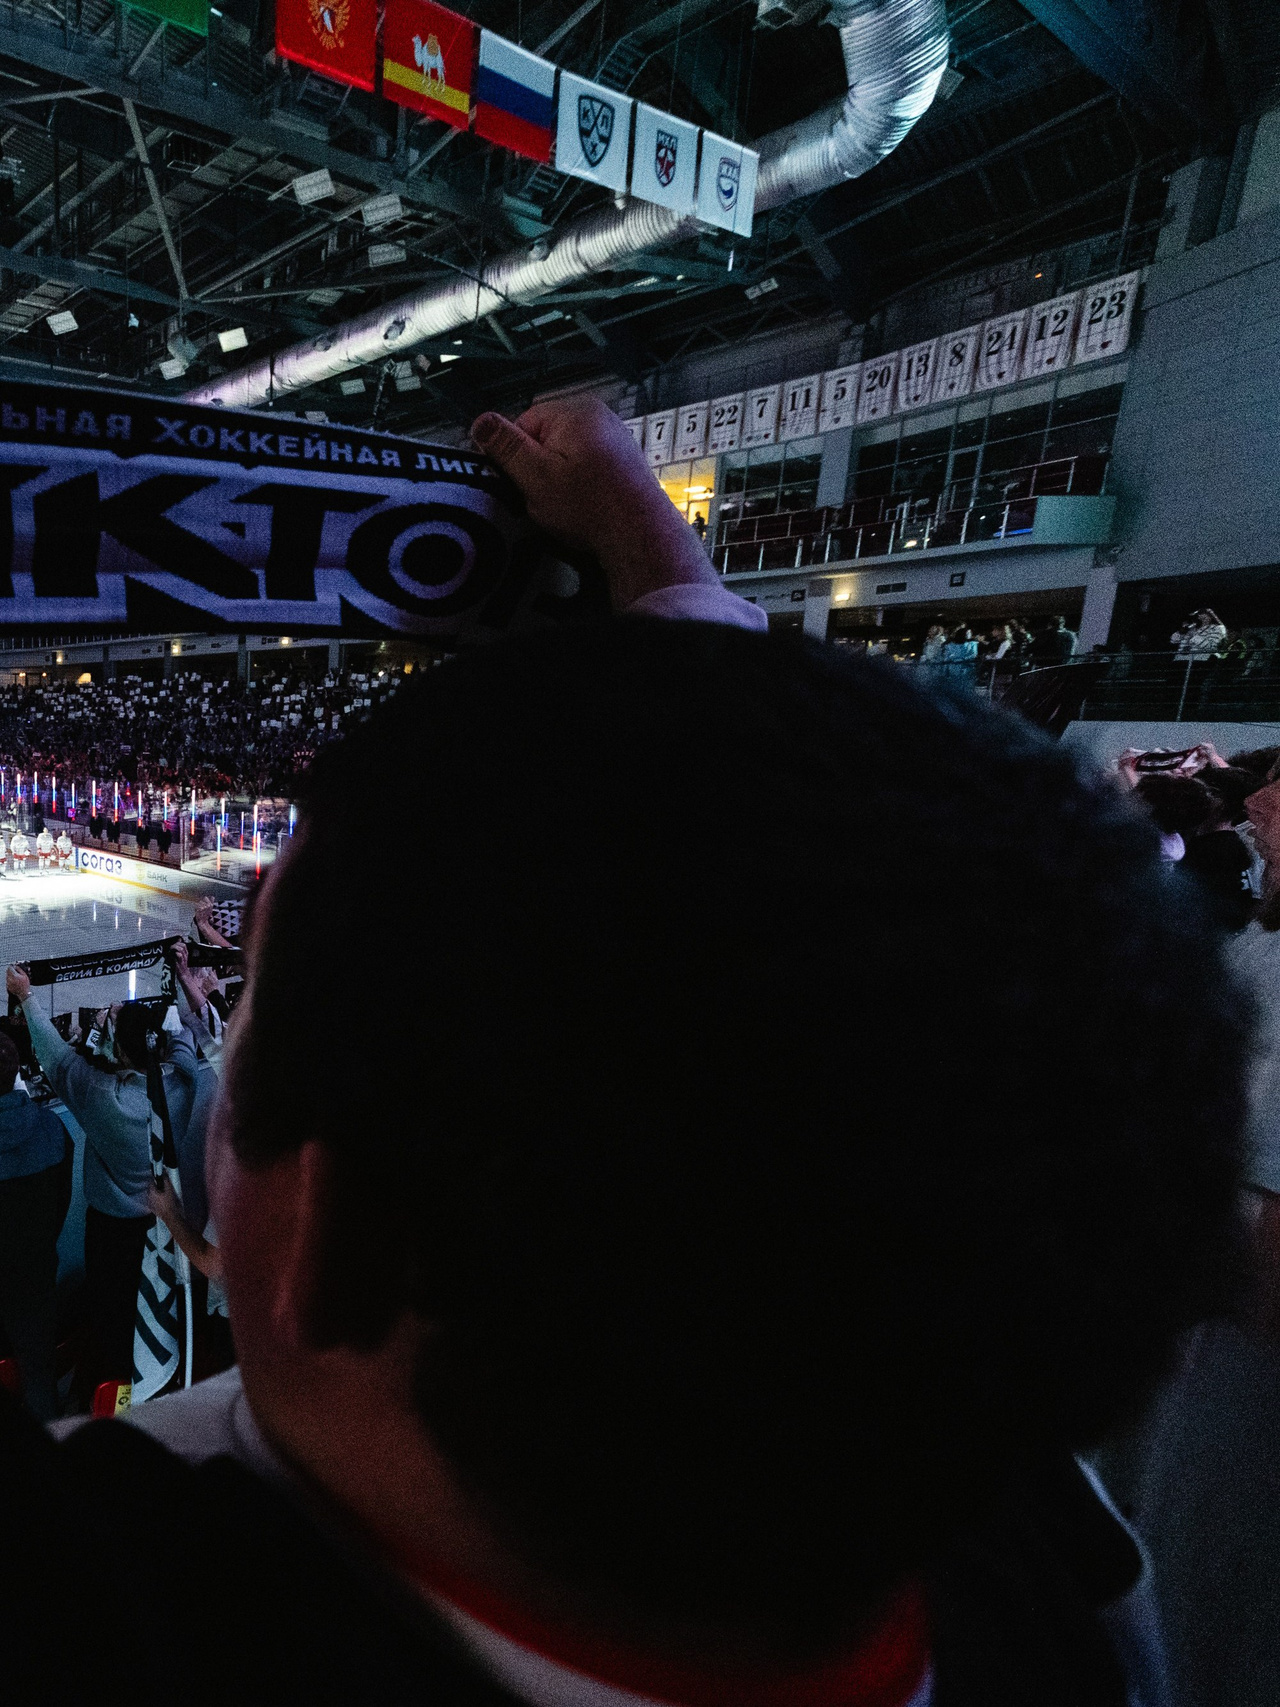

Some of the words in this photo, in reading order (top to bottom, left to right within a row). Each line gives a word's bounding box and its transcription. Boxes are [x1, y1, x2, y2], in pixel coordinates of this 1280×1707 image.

[1089, 290, 1127, 325] 23
[1035, 309, 1069, 342] 12
[986, 326, 1018, 357] 24
[949, 342, 965, 367] 8
[865, 365, 891, 393] 20
[904, 353, 930, 381] 13
[789, 388, 812, 412] 11
[833, 378, 847, 401] 5
[713, 404, 738, 428] 22
[756, 398, 768, 418] 7
[655, 421, 666, 440] 7
[686, 413, 697, 434] 5
[152, 415, 402, 469] ХОККЕЙНАЯ
[106, 956, 158, 974] КОМАНДУ
